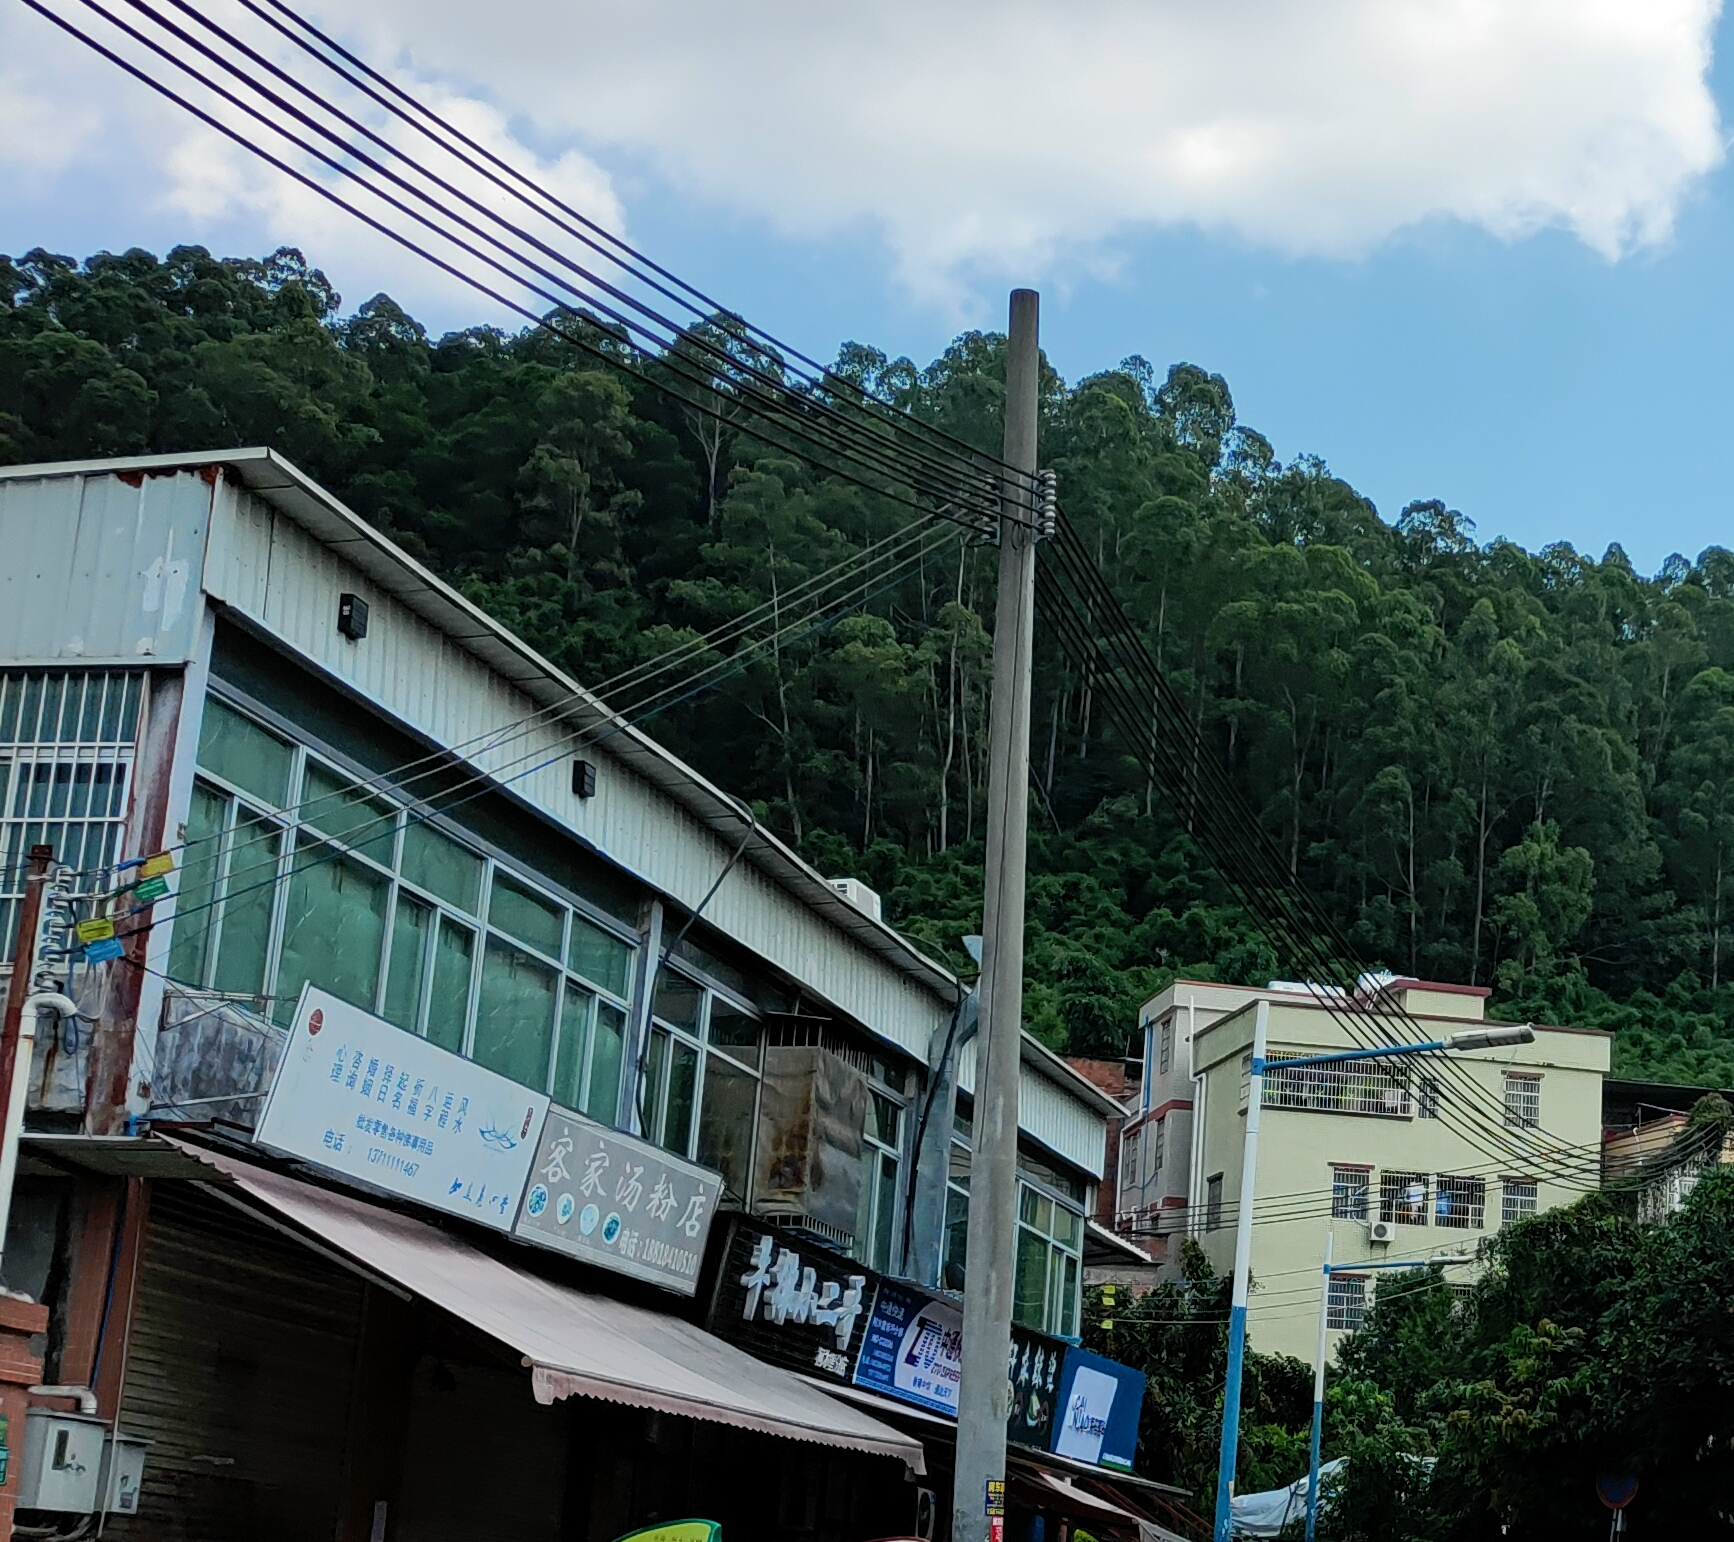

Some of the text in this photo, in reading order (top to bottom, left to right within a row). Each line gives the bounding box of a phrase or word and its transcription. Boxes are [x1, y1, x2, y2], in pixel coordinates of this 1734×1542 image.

[541, 1126, 707, 1238] 客家汤粉店
